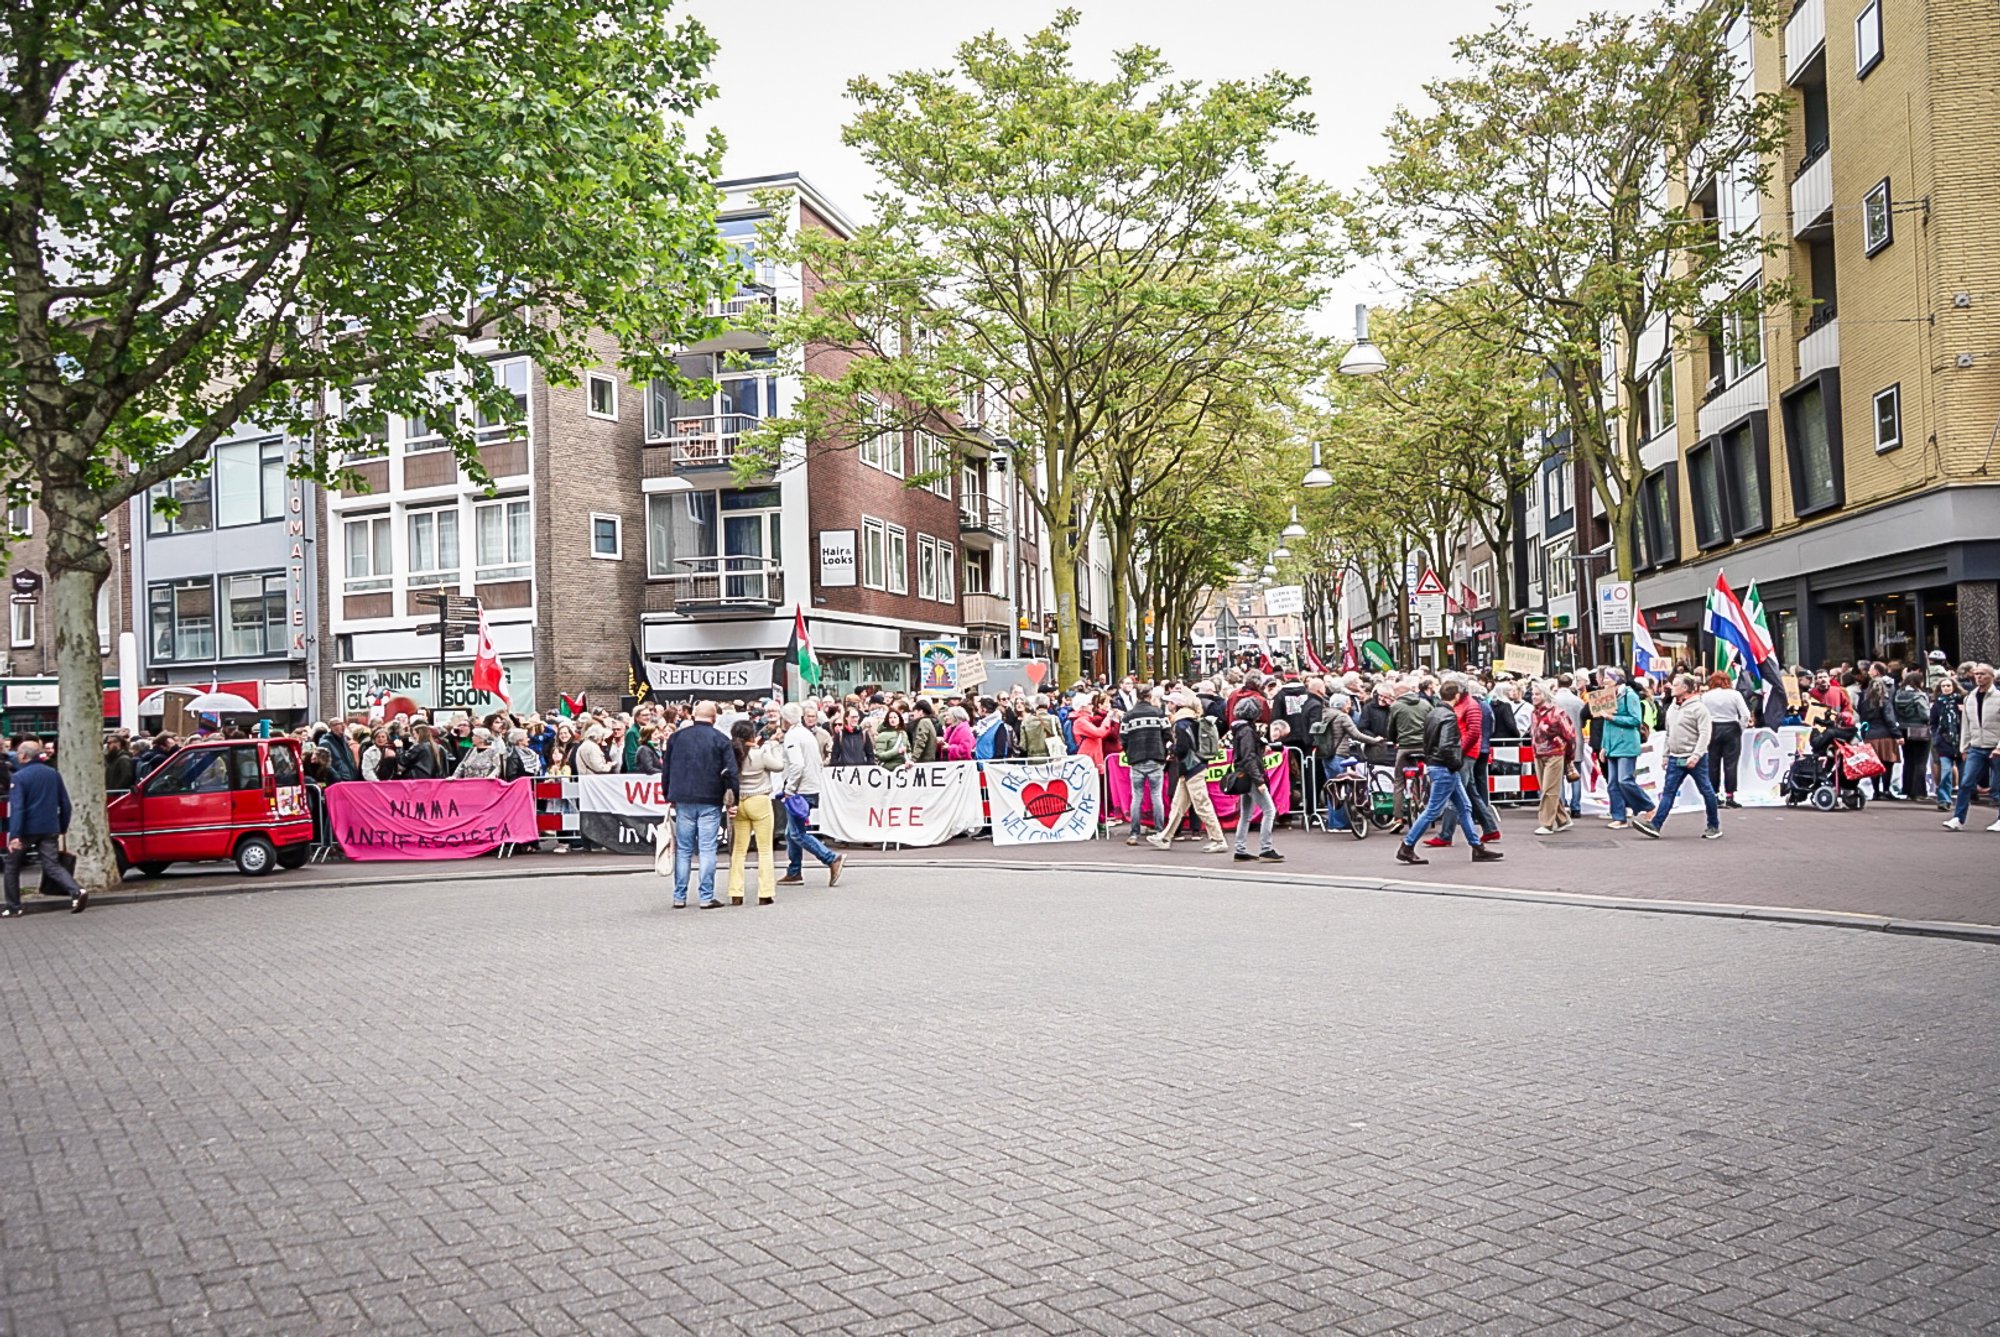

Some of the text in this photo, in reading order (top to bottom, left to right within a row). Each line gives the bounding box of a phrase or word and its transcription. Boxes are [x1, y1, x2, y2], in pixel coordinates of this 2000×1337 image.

[822, 546, 844, 556] Hair
[822, 556, 853, 565] Looks
[659, 669, 748, 686] REFUGEES
[445, 688, 491, 706] SOON
[1001, 760, 1091, 792] REFUGEES
[391, 799, 459, 820] NIMMA
[868, 806, 924, 828] NEE
[618, 821, 640, 844] in
[1001, 810, 1065, 841] WELCOME
